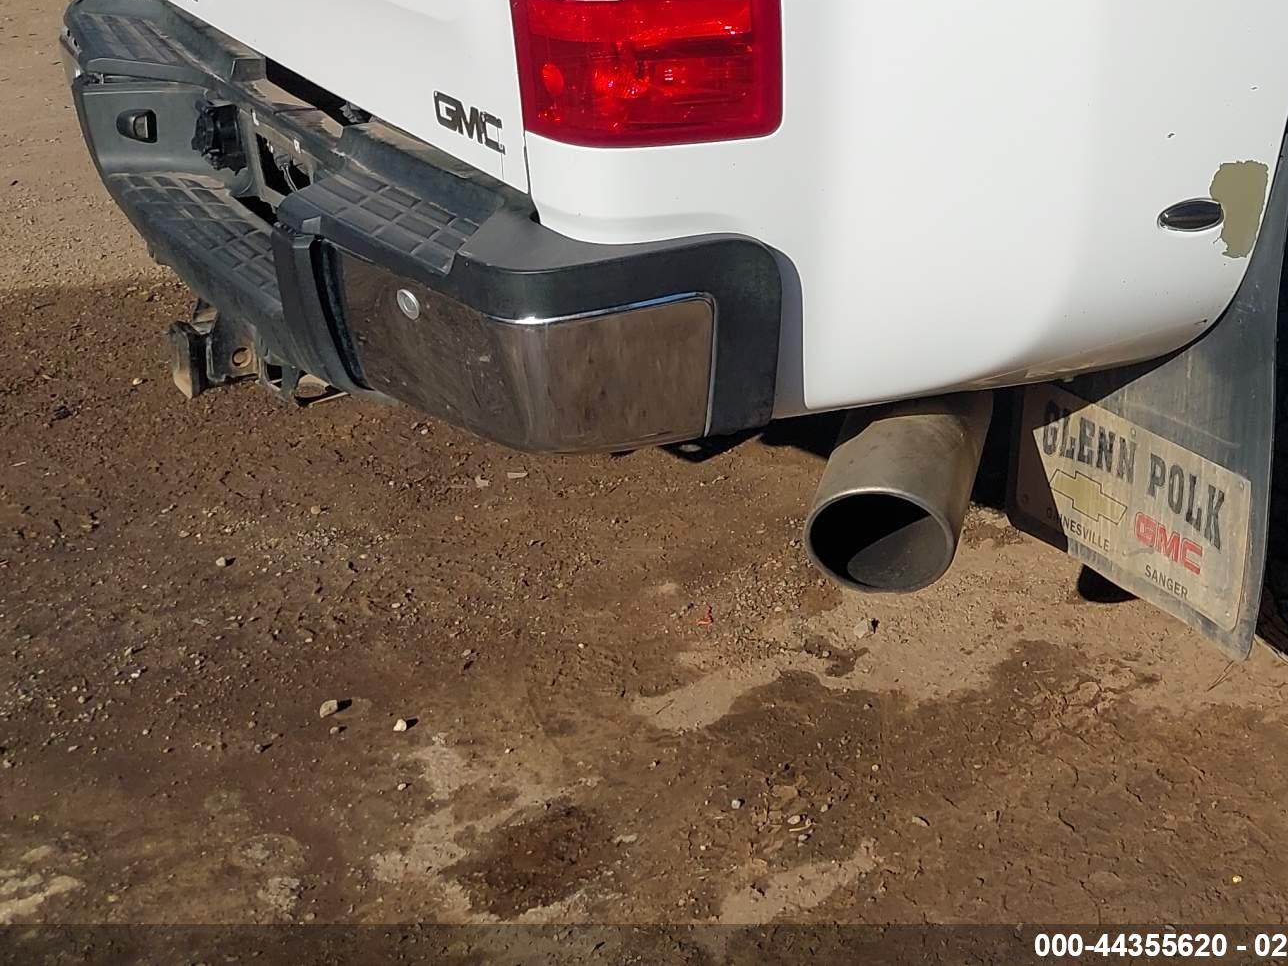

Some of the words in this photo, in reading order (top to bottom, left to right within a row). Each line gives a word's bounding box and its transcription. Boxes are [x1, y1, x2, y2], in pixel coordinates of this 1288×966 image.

[433, 90, 507, 155] GMC
[1043, 398, 1138, 485] GLENN
[1146, 452, 1226, 552] POLK
[1134, 510, 1204, 576] GMC
[1144, 563, 1189, 600] SANGER
